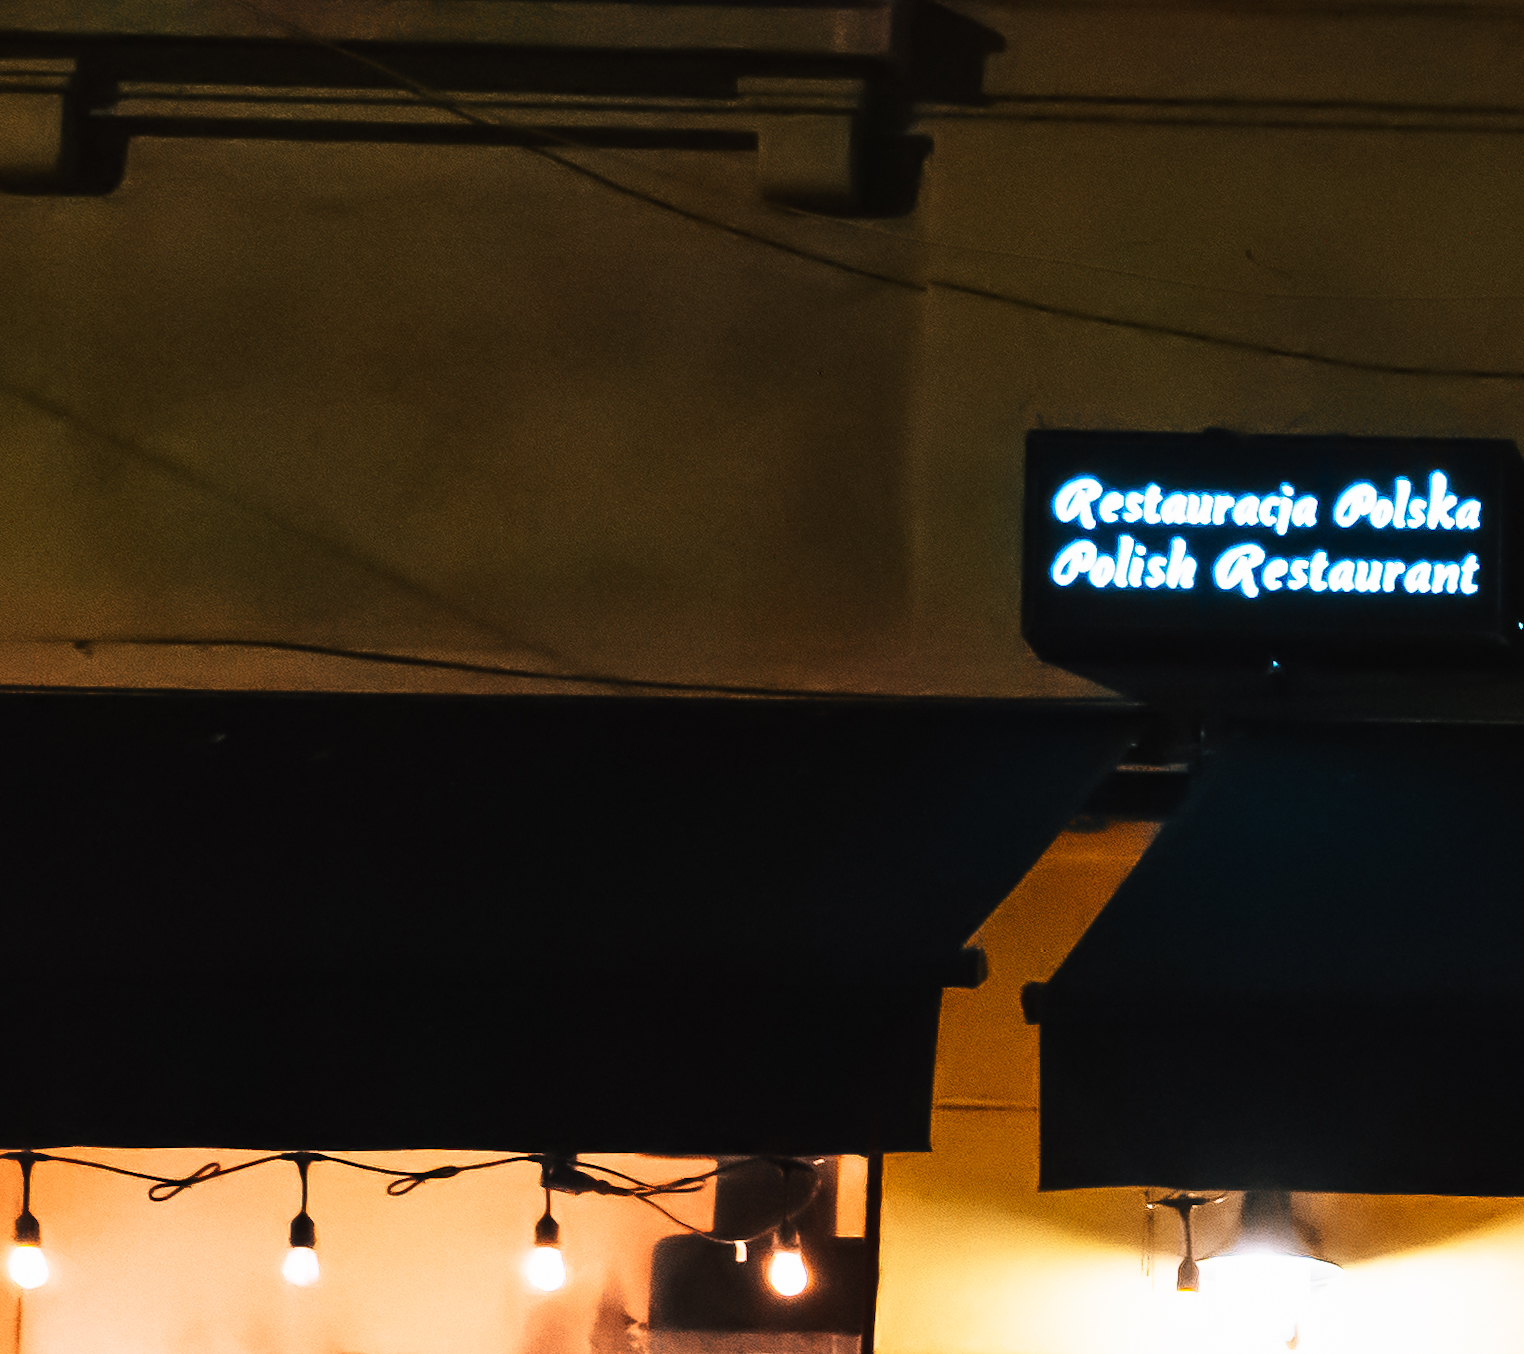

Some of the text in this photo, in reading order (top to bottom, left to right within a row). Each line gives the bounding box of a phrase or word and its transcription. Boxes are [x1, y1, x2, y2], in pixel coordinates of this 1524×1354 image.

[1053, 471, 1483, 535] Restauracja Polska
[1051, 535, 1481, 599] Polish Restaurant
